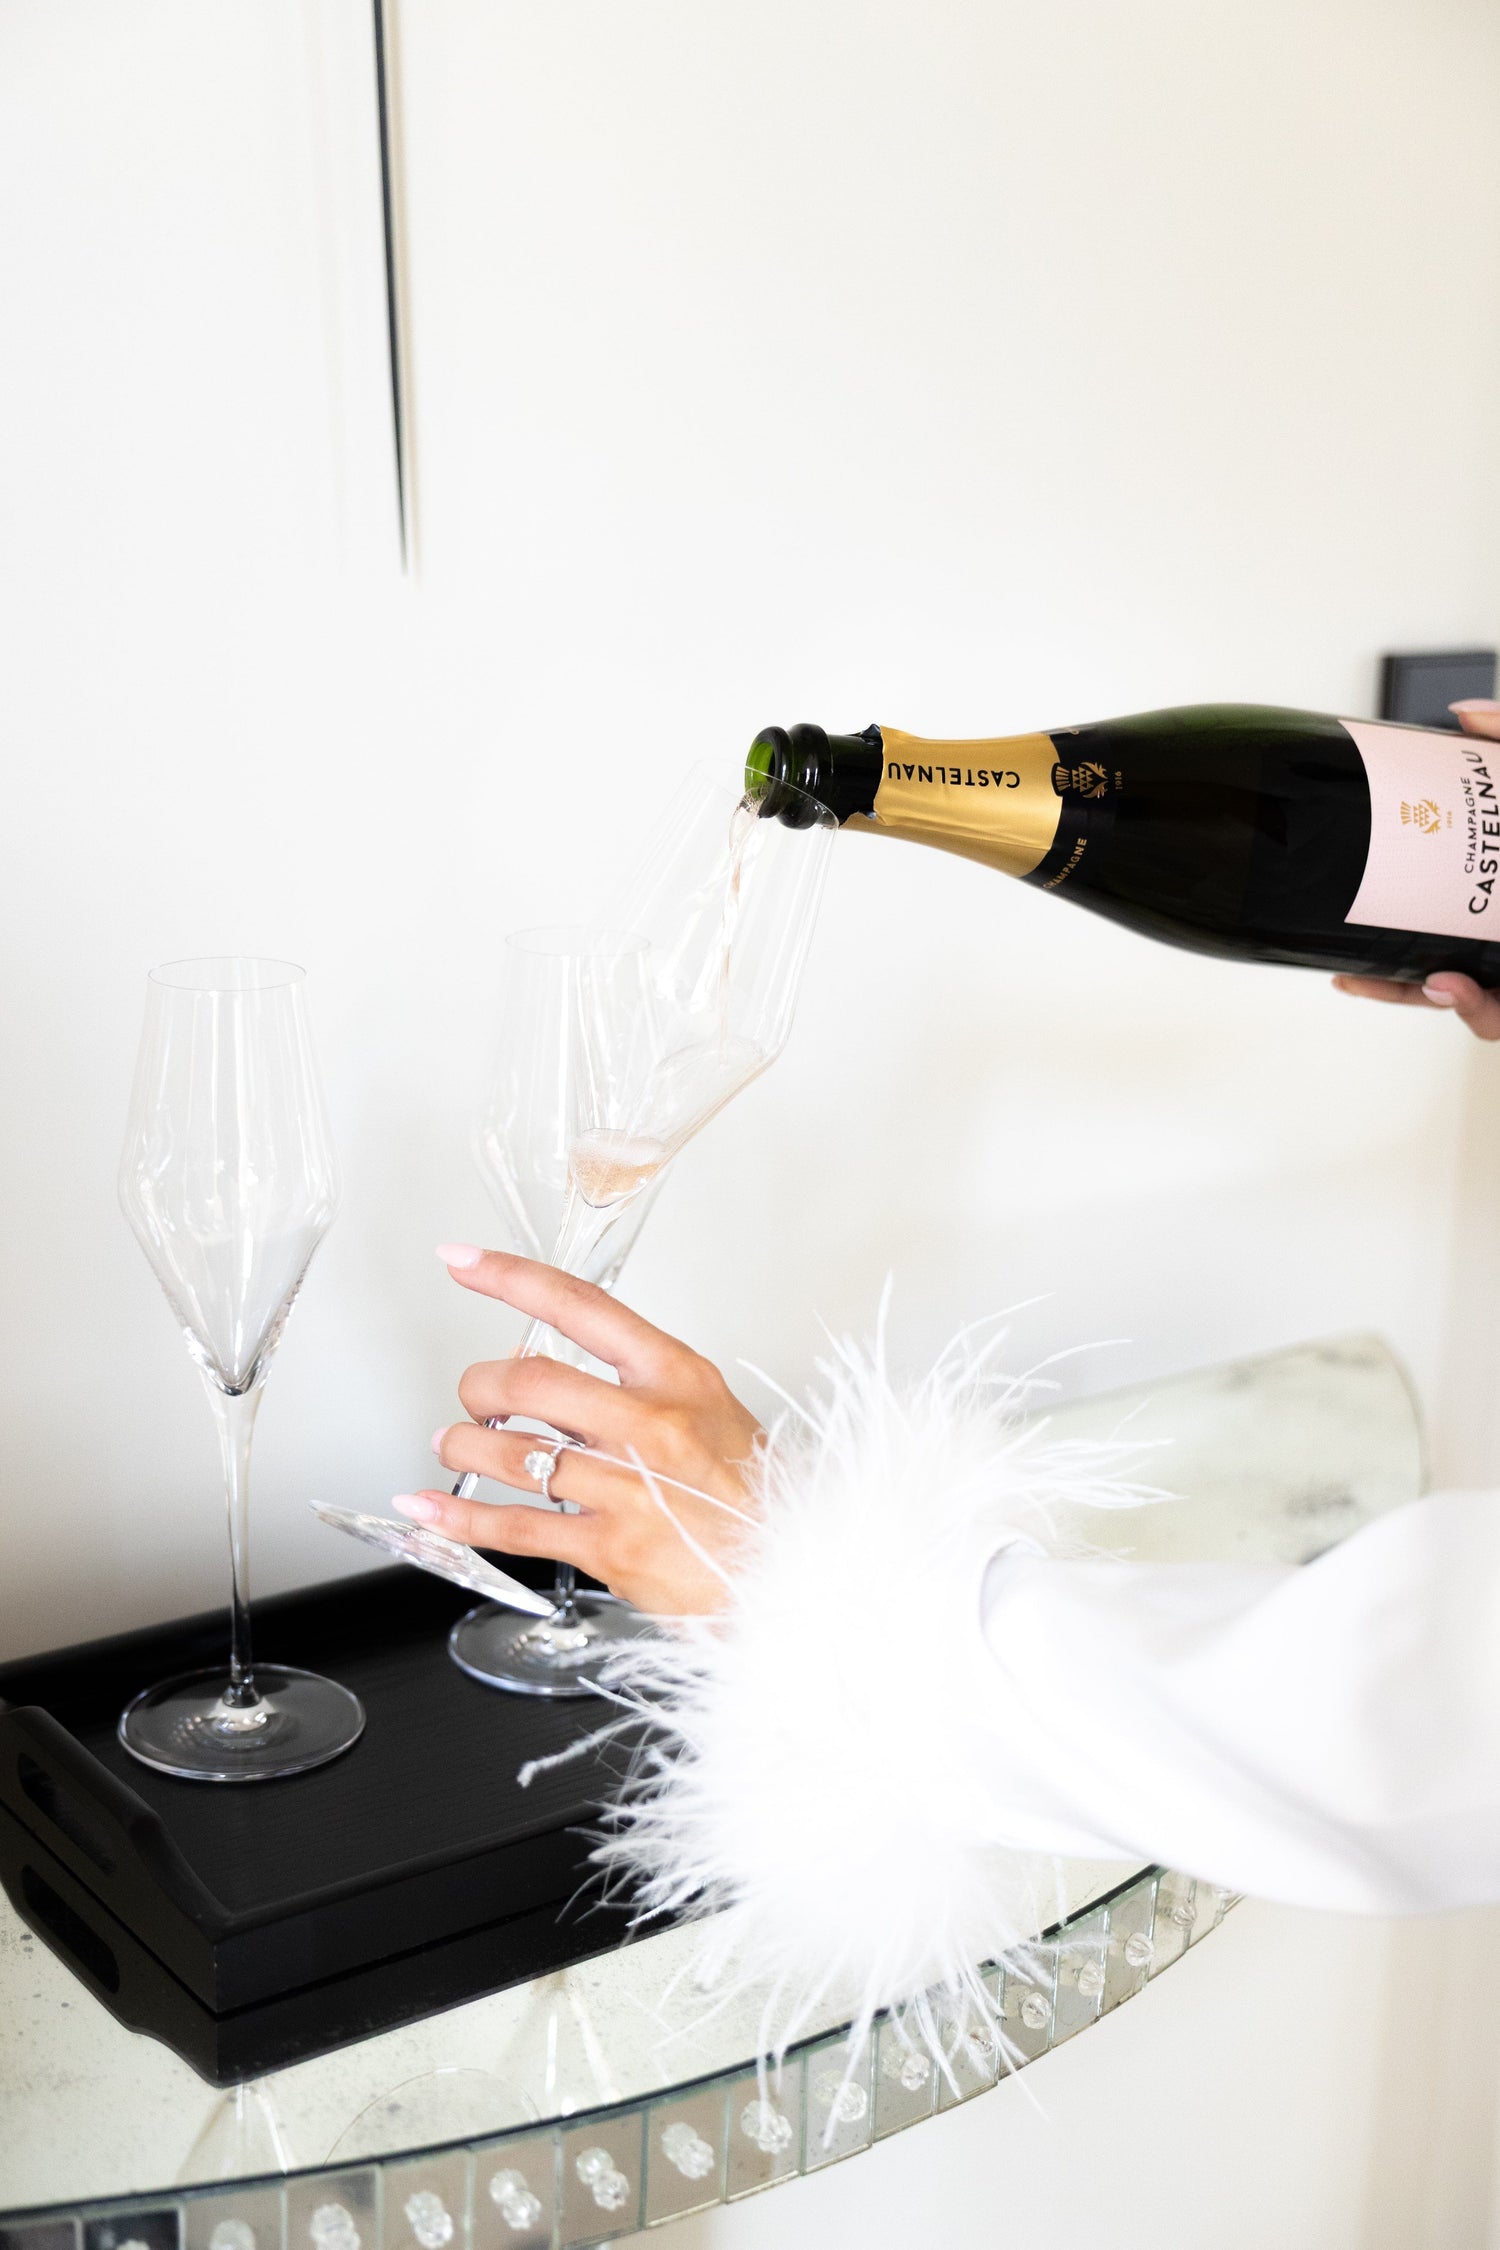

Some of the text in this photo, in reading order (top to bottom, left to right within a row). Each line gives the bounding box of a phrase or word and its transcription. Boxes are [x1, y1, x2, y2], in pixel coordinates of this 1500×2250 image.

[887, 761, 1021, 789] CASTELNAU
[1461, 777, 1477, 874] CHAMPAGNE
[1461, 750, 1500, 915] CASTELNAU
